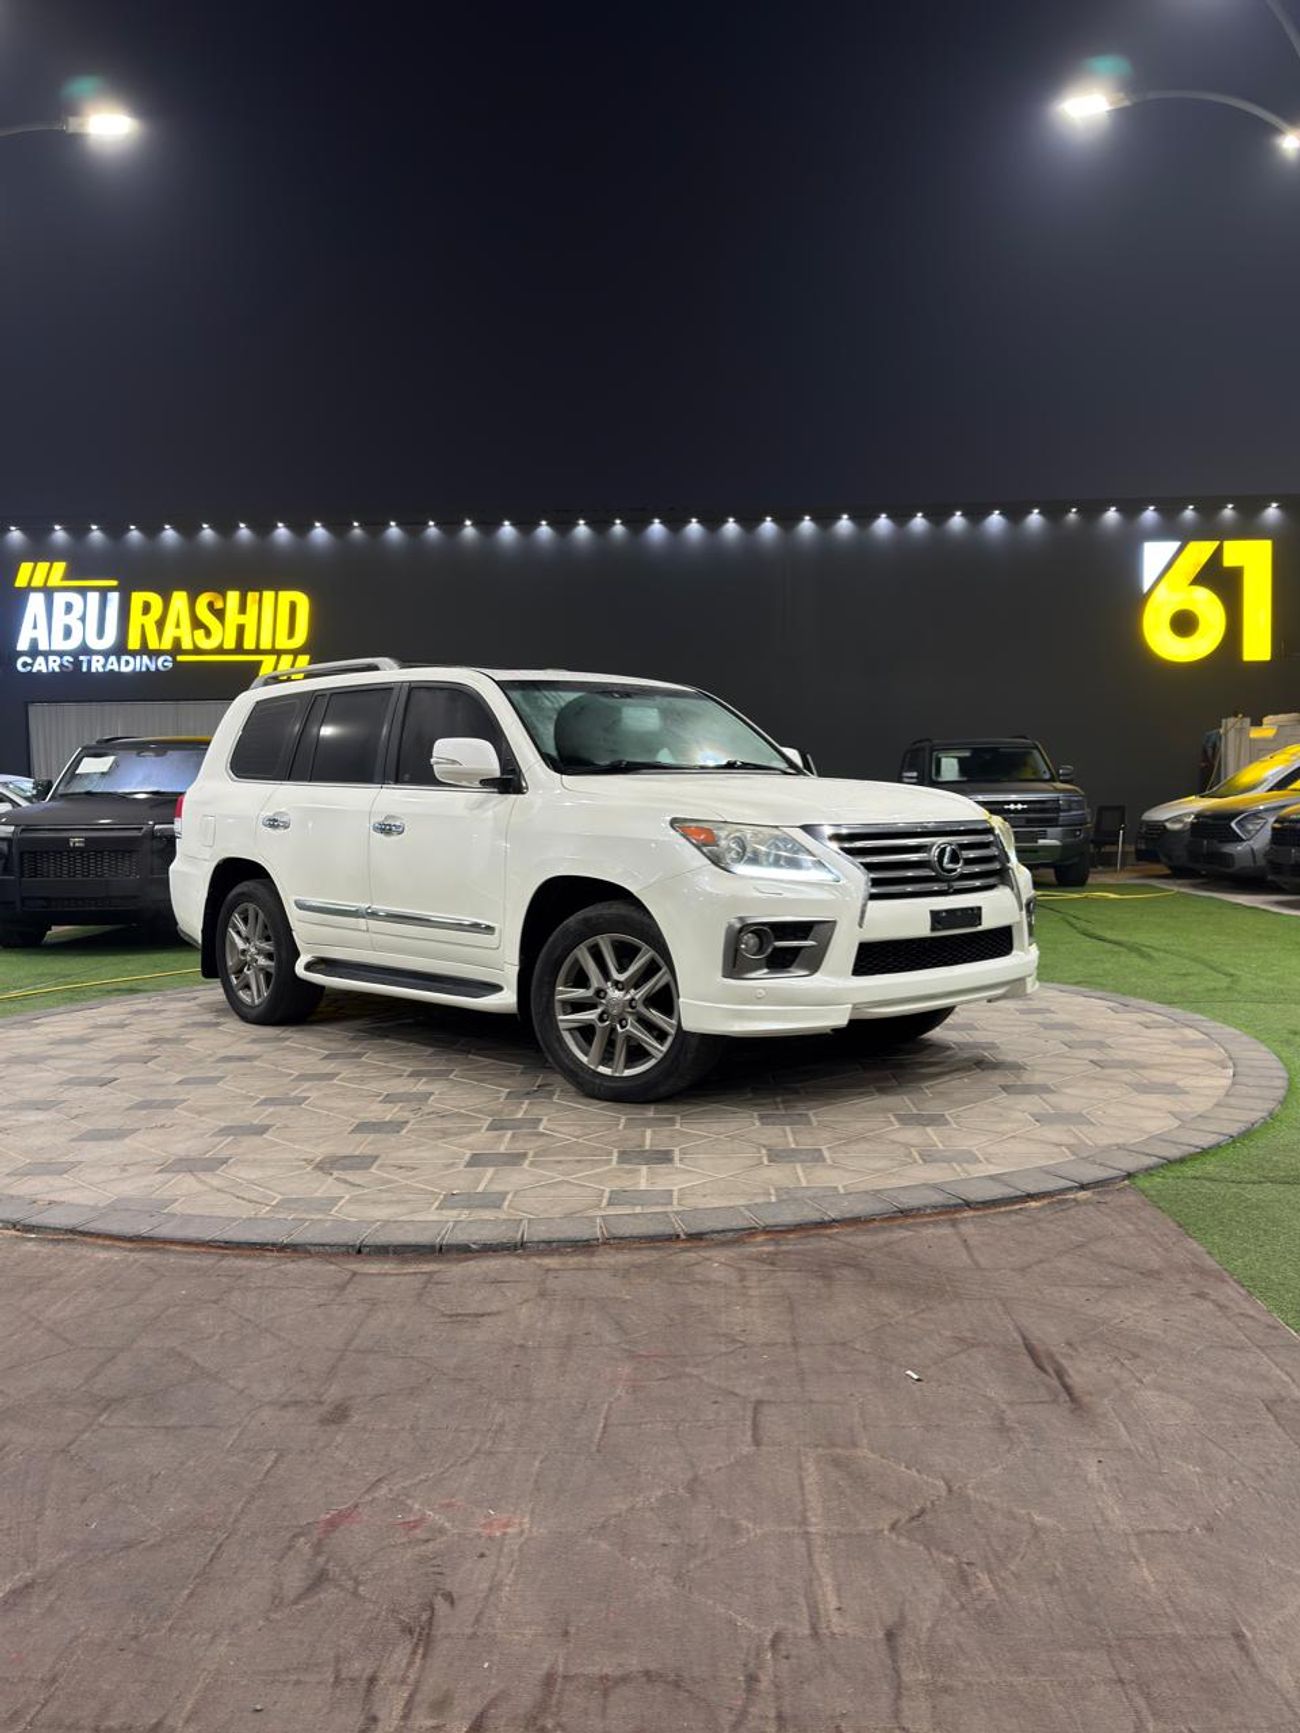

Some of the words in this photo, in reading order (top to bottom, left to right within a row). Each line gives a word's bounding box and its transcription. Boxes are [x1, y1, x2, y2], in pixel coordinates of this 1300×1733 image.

[16, 591, 119, 651] ABU
[127, 590, 310, 650] RASHID
[1142, 540, 1272, 662] 61
[16, 655, 74, 672] CARS
[79, 655, 173, 672] TRADING
